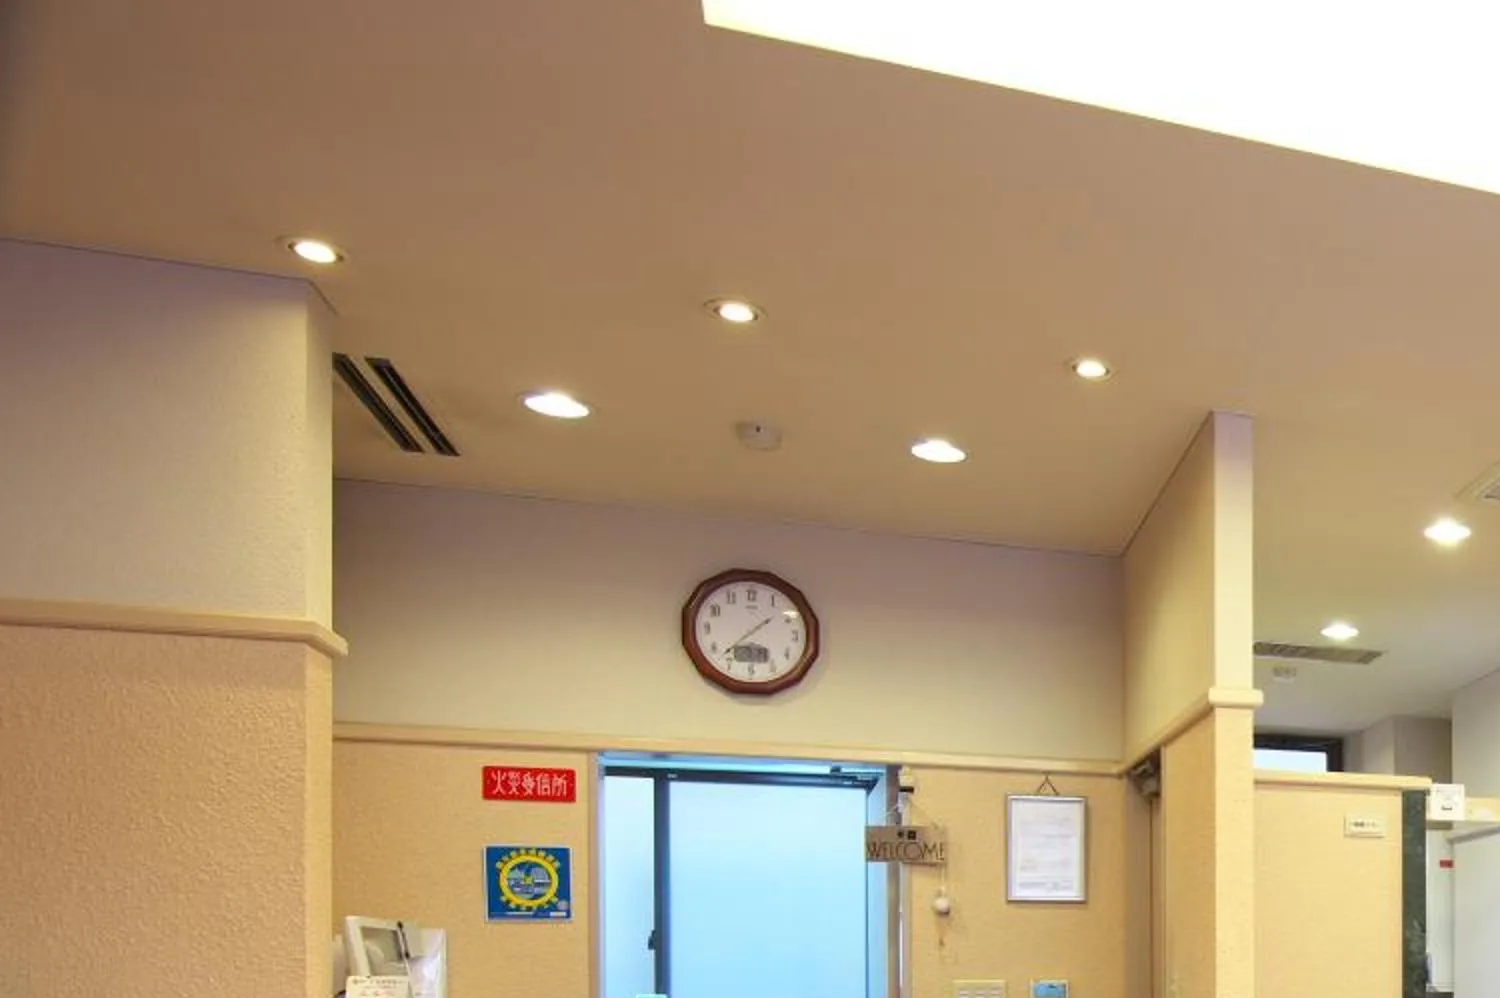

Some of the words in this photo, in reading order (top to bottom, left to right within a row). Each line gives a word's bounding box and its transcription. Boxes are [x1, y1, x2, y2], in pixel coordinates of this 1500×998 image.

[726, 589, 737, 605] 11
[747, 589, 757, 601] 12
[710, 603, 721, 617] 10
[491, 770, 568, 797] 火災受信所
[865, 840, 945, 861] WELCOME
